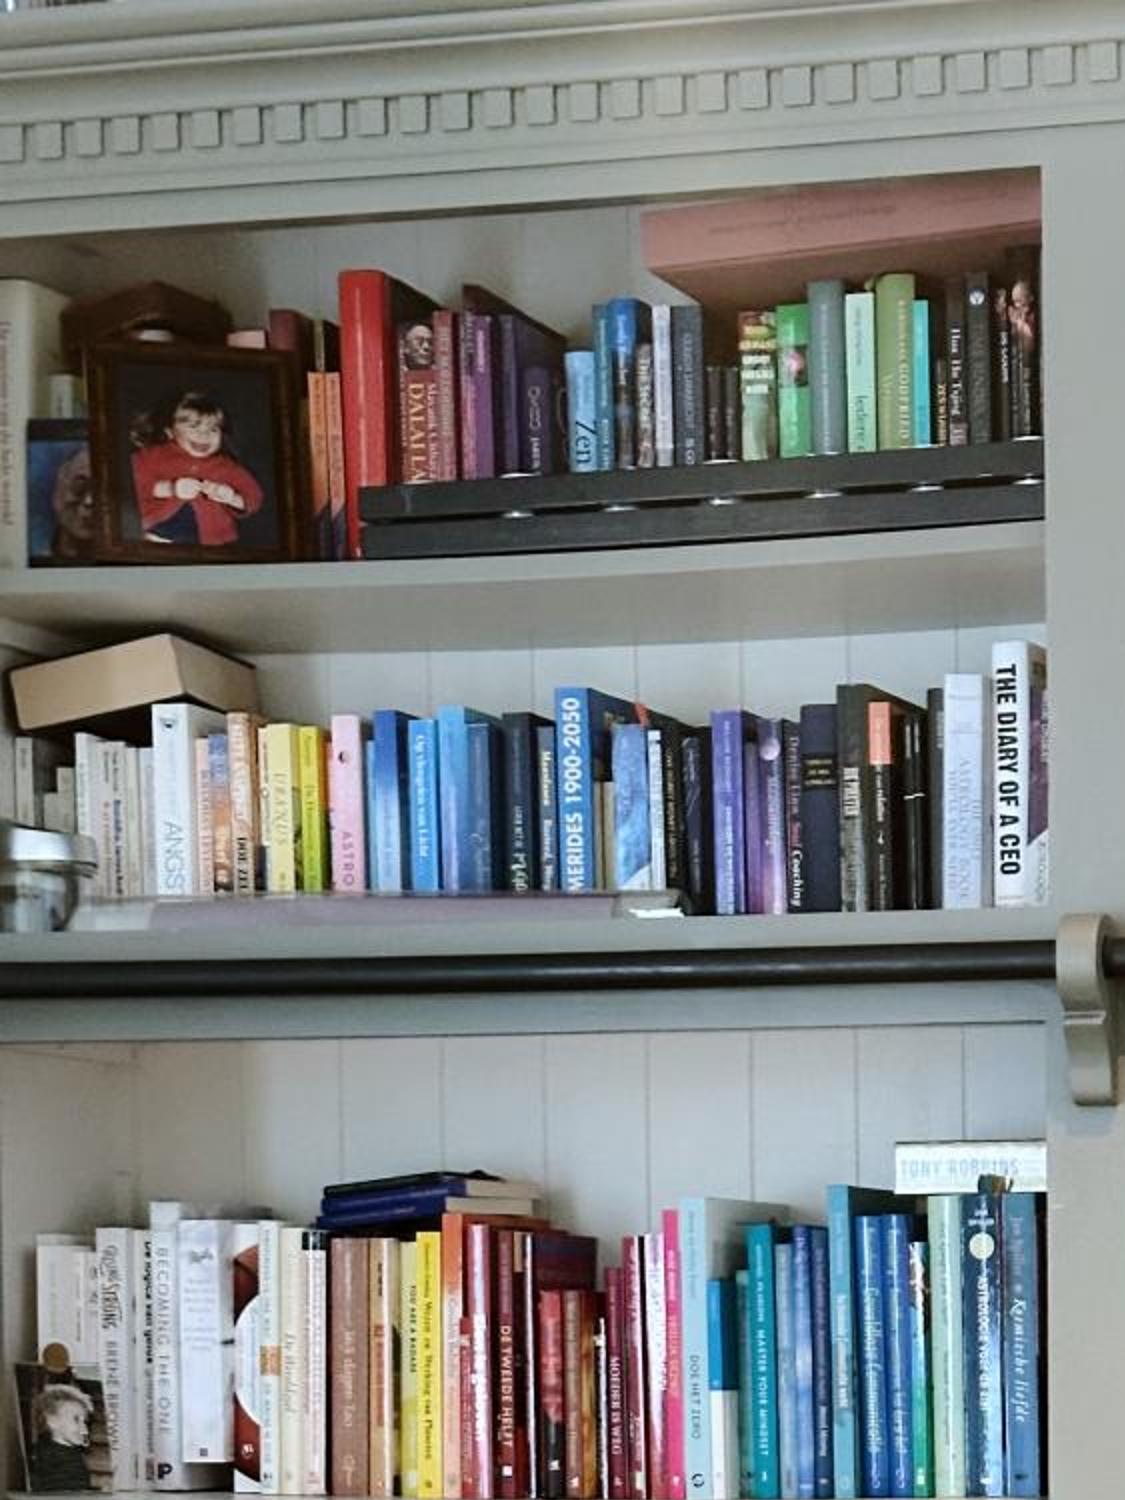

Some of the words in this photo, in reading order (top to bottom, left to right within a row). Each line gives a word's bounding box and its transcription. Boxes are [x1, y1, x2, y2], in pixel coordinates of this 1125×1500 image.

[408, 383, 426, 448] DALAI
[575, 420, 598, 465] Zen
[996, 664, 1017, 704] THE
[997, 712, 1018, 773] DIARY
[999, 781, 1019, 807] OF
[999, 814, 1019, 827] A
[342, 831, 354, 886] ASTRO
[1000, 834, 1021, 875] CEO
[789, 849, 804, 907] Coaching
[101, 1283, 121, 1330] STRONG
[156, 1247, 169, 1346] BECOMING
[501, 1326, 511, 1342] DE
[756, 1330, 767, 1373] MASTER
[159, 1355, 169, 1386] THE
[501, 1347, 512, 1402] TWEEDE
[689, 1355, 701, 1379] DOE
[159, 1397, 170, 1434] ONE
[690, 1383, 701, 1405] HET
[759, 1408, 769, 1457] MINDSET
